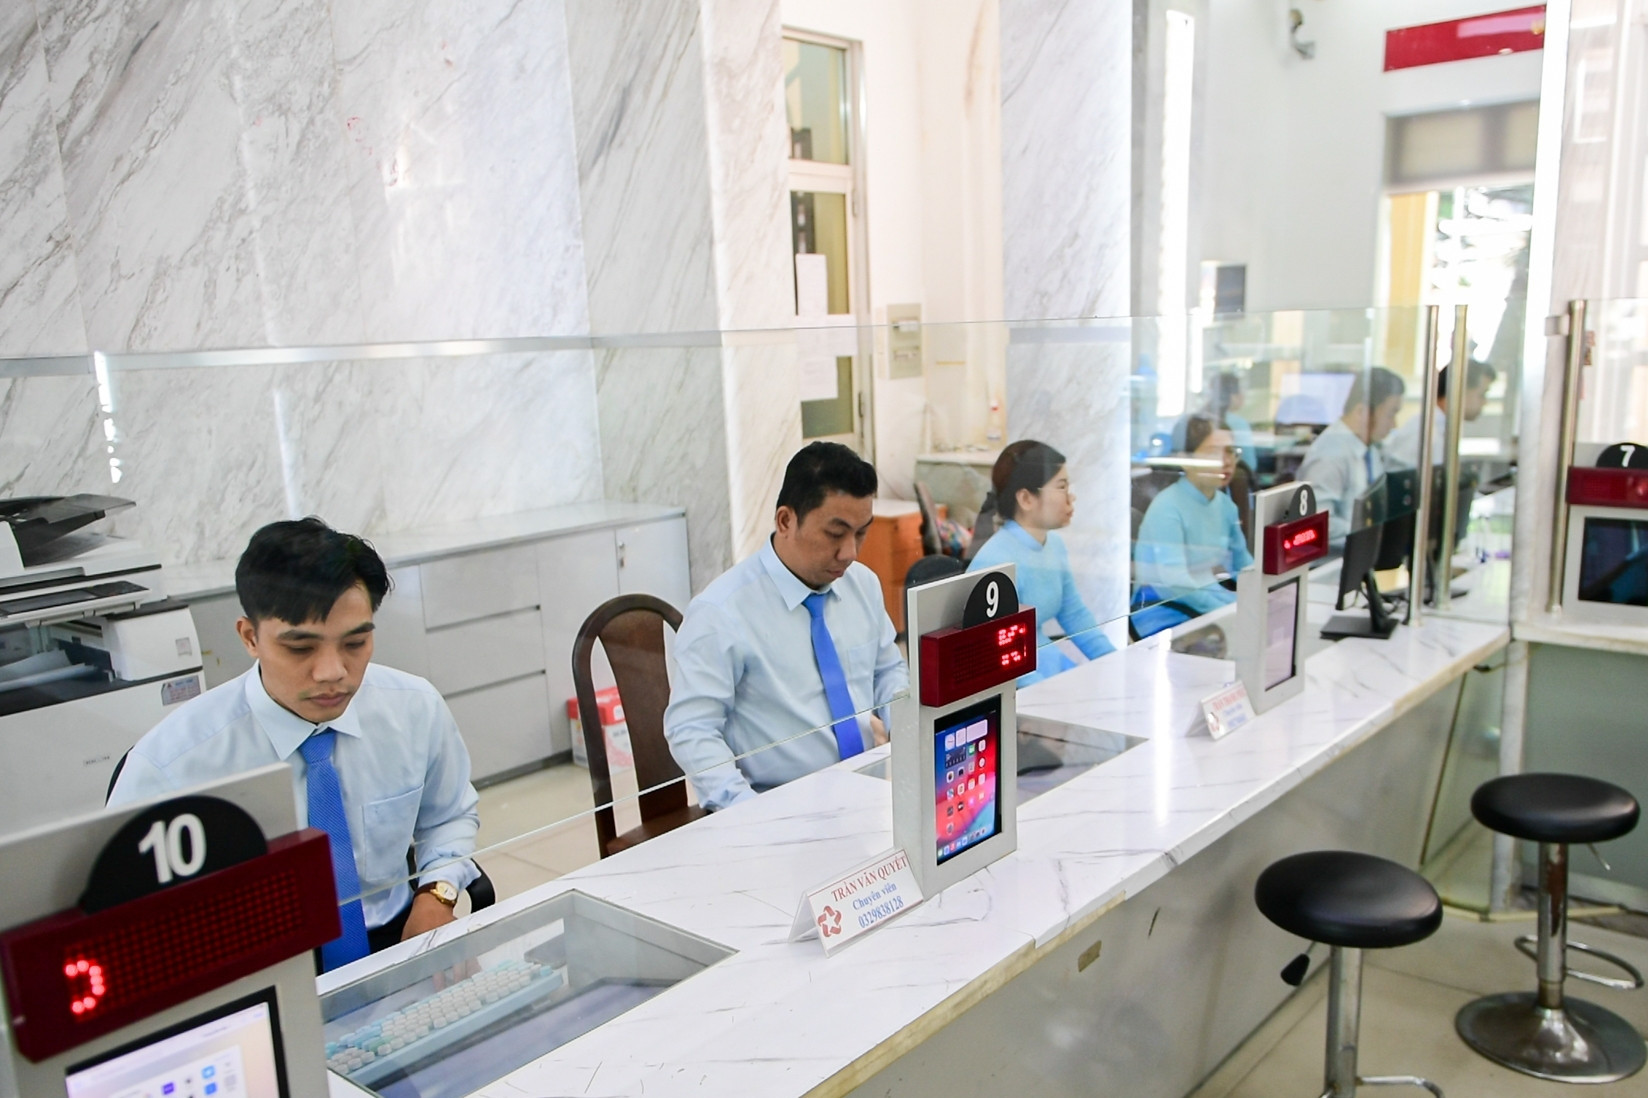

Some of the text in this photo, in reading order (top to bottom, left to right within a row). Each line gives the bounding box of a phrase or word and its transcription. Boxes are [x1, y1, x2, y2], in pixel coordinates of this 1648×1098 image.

[1620, 445, 1635, 467] 7
[1299, 489, 1308, 516] 8
[986, 581, 999, 618] 9
[138, 813, 207, 884] 10
[857, 871, 878, 888] VĂN
[852, 882, 897, 910] Chuyên viên
[858, 895, 904, 928] 0329838128
